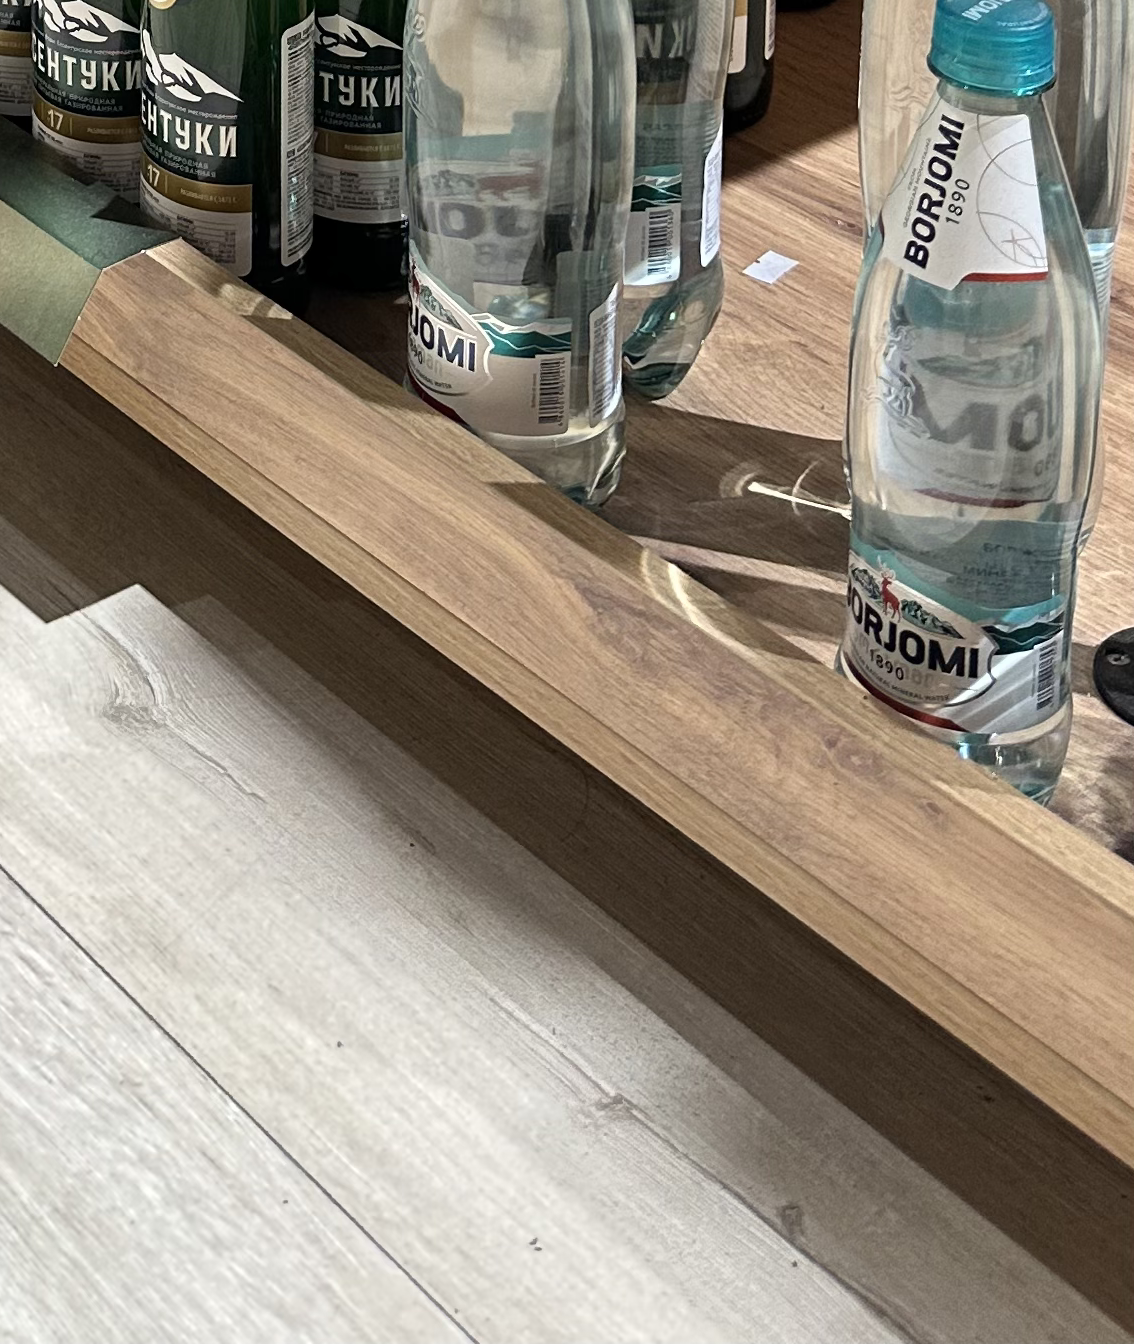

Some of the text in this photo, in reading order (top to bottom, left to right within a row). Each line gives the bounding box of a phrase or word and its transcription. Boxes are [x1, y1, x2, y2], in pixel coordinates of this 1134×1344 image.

[31, 32, 142, 92] СЕНТУКИ
[141, 90, 238, 158] ЕНТУКИ
[902, 113, 966, 270] BORJOMI
[945, 178, 971, 226] 1890
[411, 305, 479, 374] JOMI
[869, 648, 905, 682] 1890
